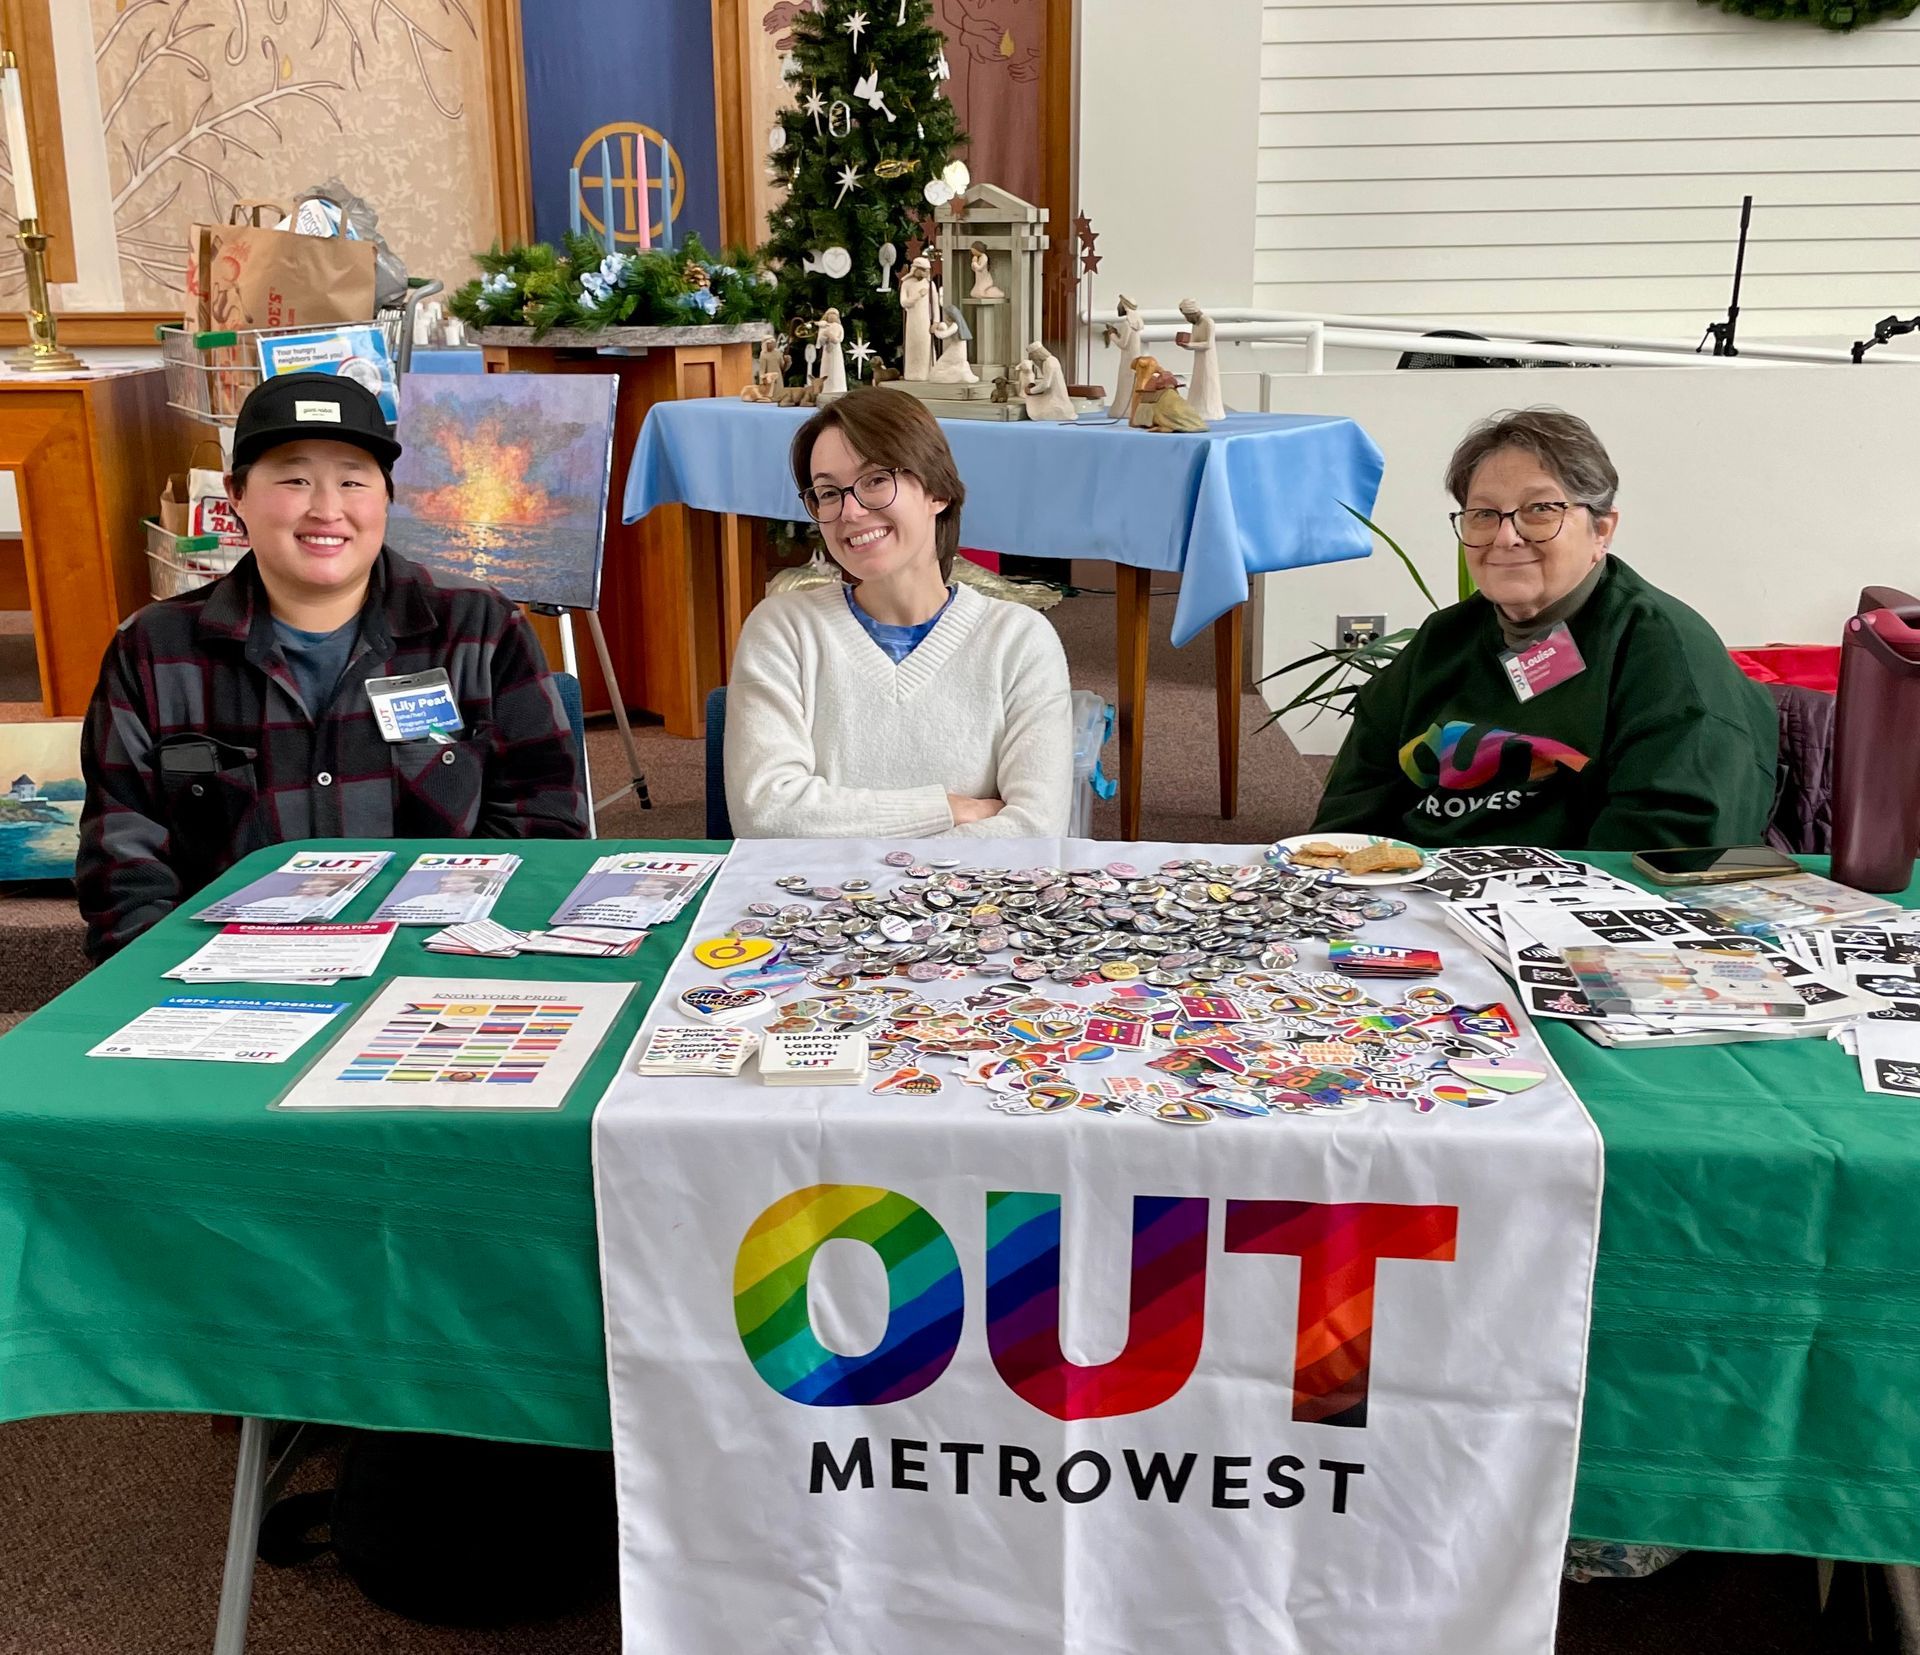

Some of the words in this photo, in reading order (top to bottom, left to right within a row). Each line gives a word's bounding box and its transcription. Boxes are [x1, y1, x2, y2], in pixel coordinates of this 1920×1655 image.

[268, 292, 283, 327] OE'S
[292, 347, 316, 355] hungry
[278, 355, 311, 364] neighbors
[1520, 647, 1557, 670] Louisa
[1510, 668, 1526, 691] OUT
[393, 700, 416, 713] Lily
[380, 708, 394, 731] OUT
[293, 859, 372, 869] OUT
[419, 857, 499, 866] OUT
[620, 861, 699, 872] OUT
[1350, 944, 1413, 959] OUT
[687, 991, 756, 1002] CHOOSE
[265, 1001, 335, 1009] PROGRAMS
[234, 1050, 279, 1060] OUT
[1310, 1055, 1353, 1064] SLAY
[785, 1058, 836, 1067] OUT
[732, 1182, 1460, 1428] OUT
[809, 1434, 1366, 1515] METROWEST
